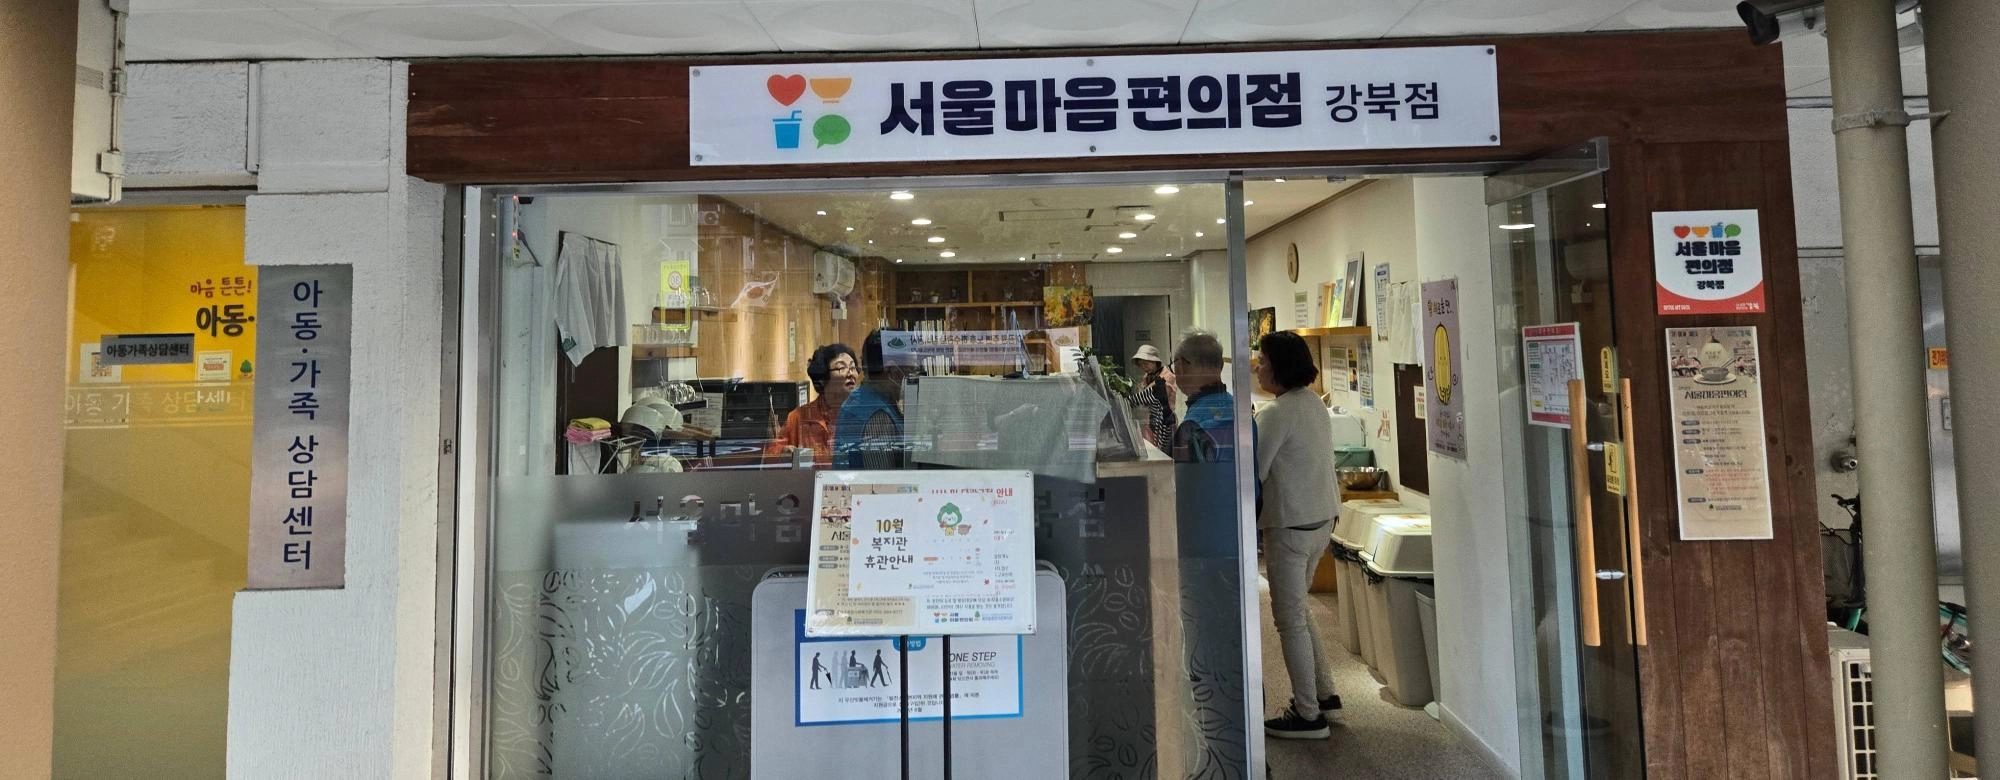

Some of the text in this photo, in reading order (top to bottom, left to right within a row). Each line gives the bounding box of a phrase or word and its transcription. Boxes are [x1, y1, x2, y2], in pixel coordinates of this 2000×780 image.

[880, 72, 1440, 136] 서울 마음 편의점 강북점
[1685, 259, 1734, 275] 편의점
[190, 276, 252, 298] 마음 튼튼!
[1697, 280, 1725, 290] 강북점
[106, 343, 190, 358] 아동가족상담센터
[282, 280, 323, 570] 아동·가족 상담센터
[996, 487, 1013, 498] 안내
[876, 518, 904, 534] 10월
[871, 536, 908, 552] 복지관
[864, 554, 914, 570] 휴관안내
[949, 651, 997, 662] ONE STEP
